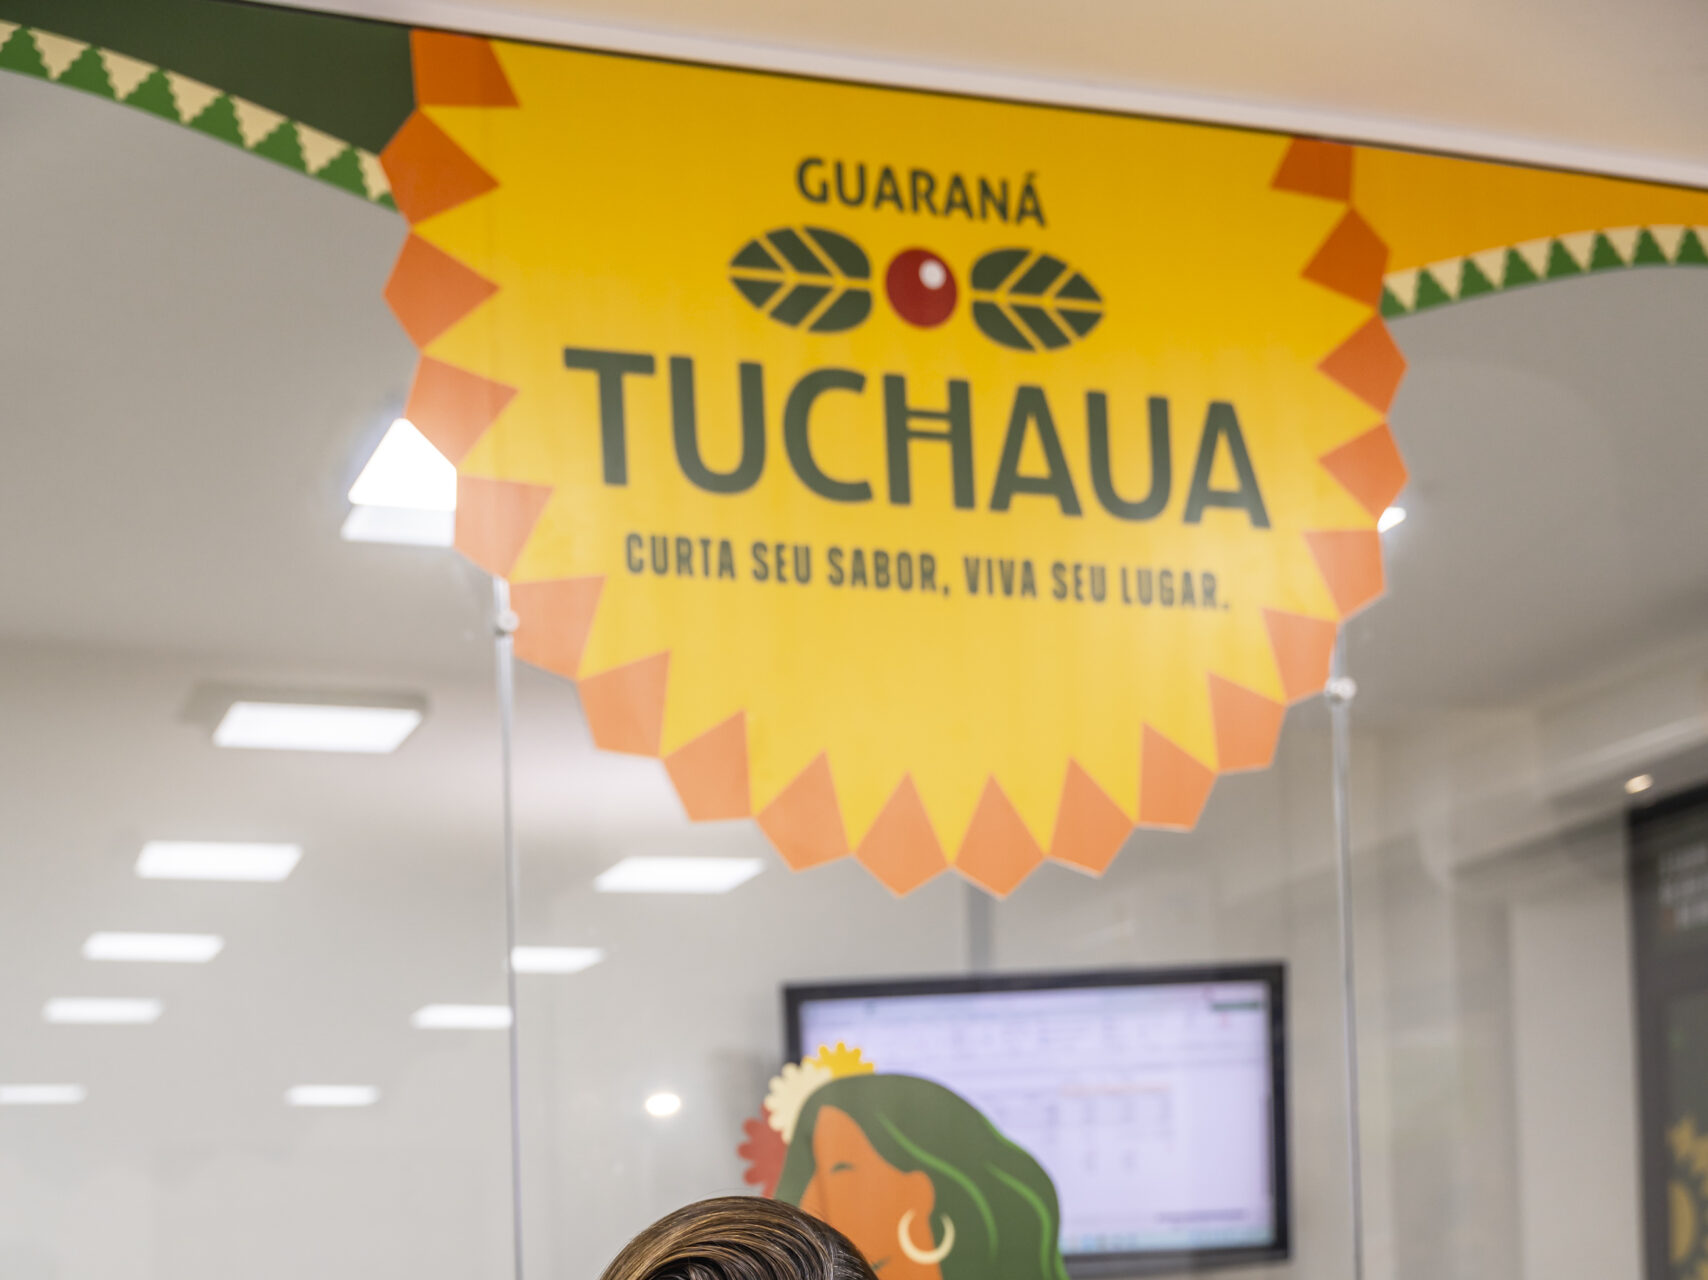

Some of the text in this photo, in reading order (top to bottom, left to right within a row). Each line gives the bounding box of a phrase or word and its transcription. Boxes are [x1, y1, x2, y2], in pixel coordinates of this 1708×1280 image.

[795, 156, 1047, 229] GUARANÁ
[563, 346, 1272, 529] TUCHAUA
[625, 532, 1231, 612] CURTA SEU SABOR, VIVA SEU LUGAR.
